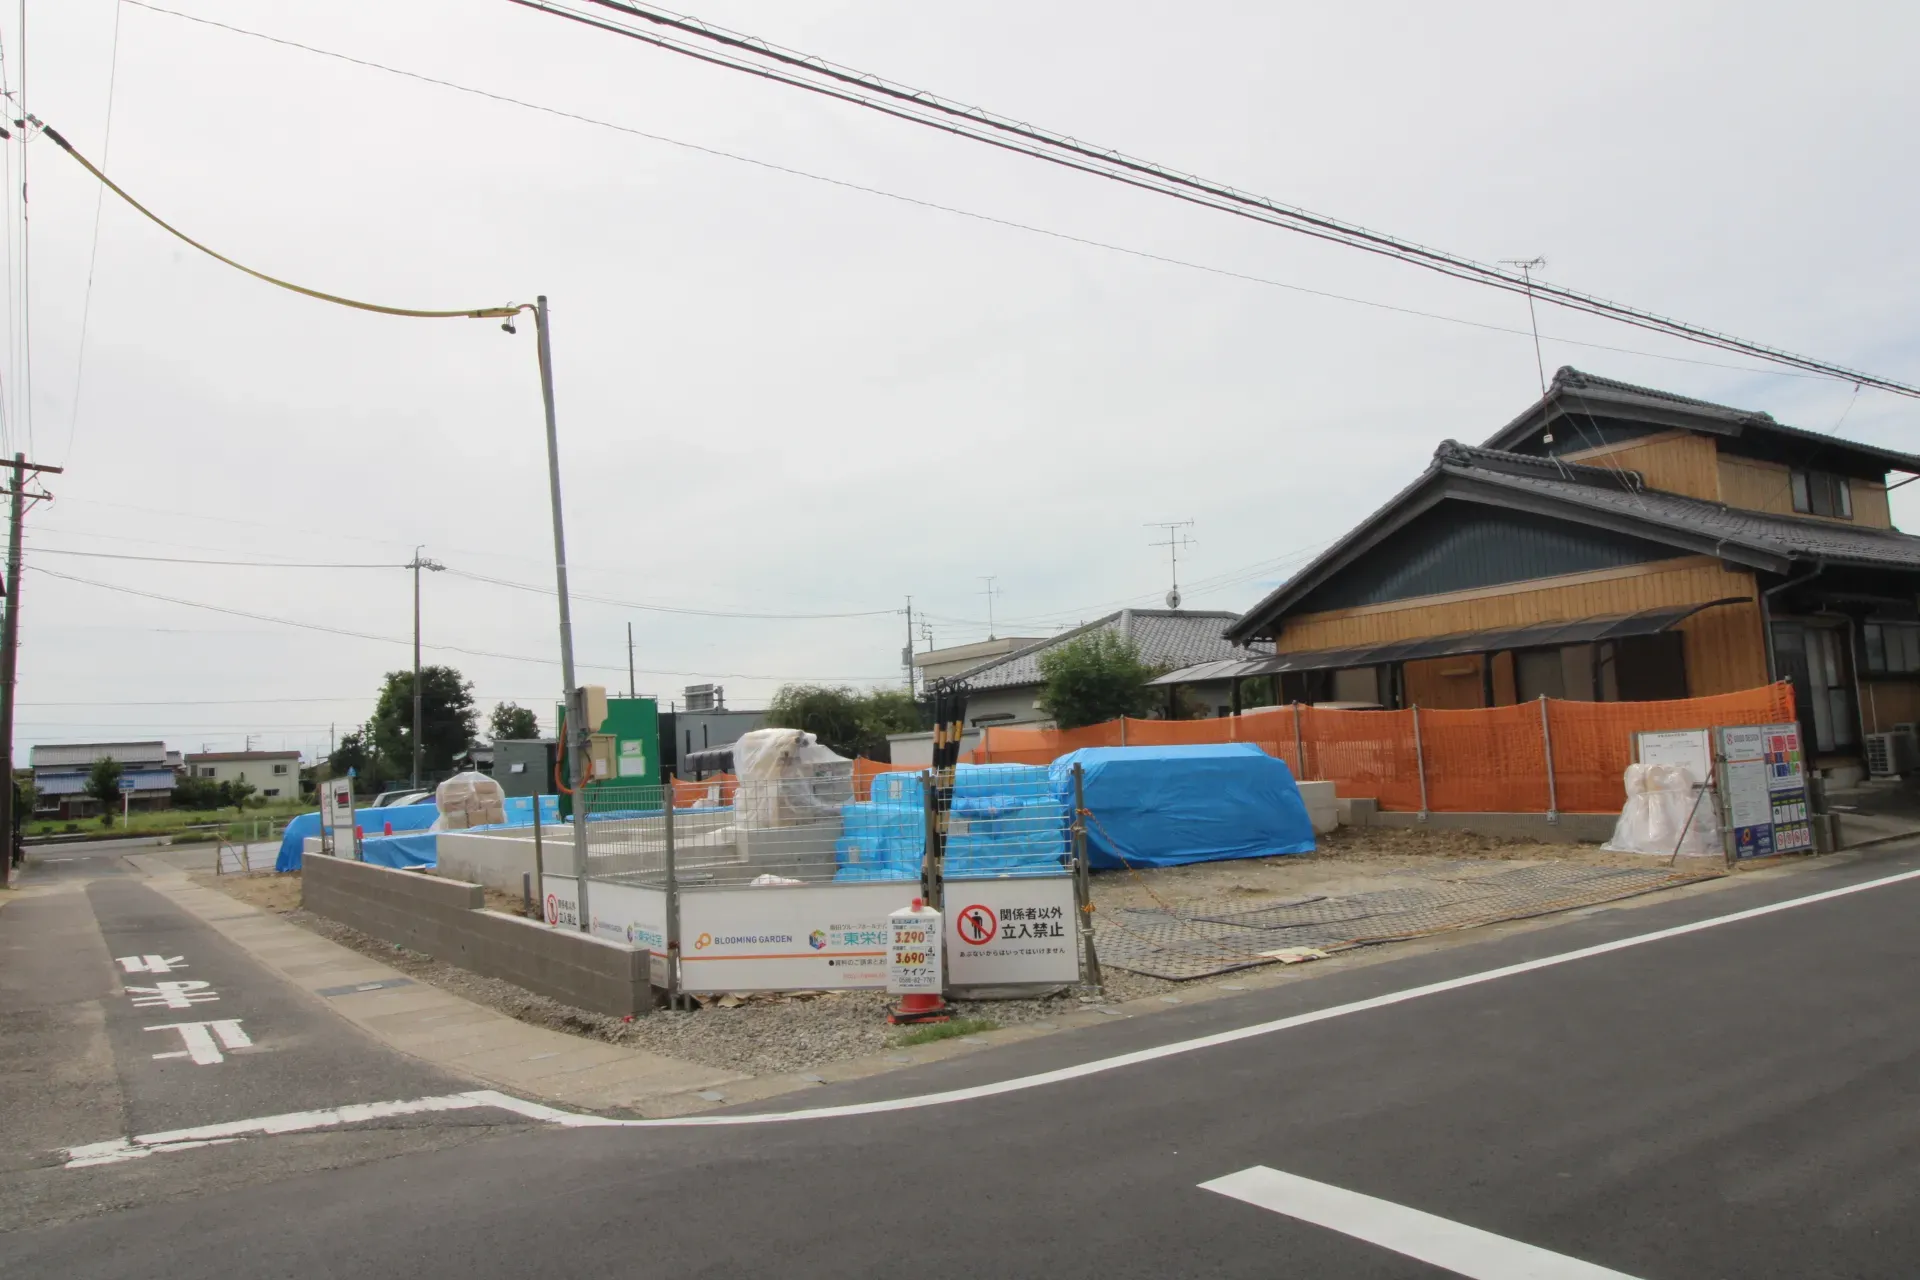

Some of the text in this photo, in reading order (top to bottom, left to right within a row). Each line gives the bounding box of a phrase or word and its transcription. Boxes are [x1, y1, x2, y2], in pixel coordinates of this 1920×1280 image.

[1000, 906, 1063, 921] 関係者以外
[1001, 922, 1064, 940] 立入禁止
[714, 935, 793, 945] BLOOMING GARDEN
[960, 948, 1065, 958] あぶないからはいってはいけません
